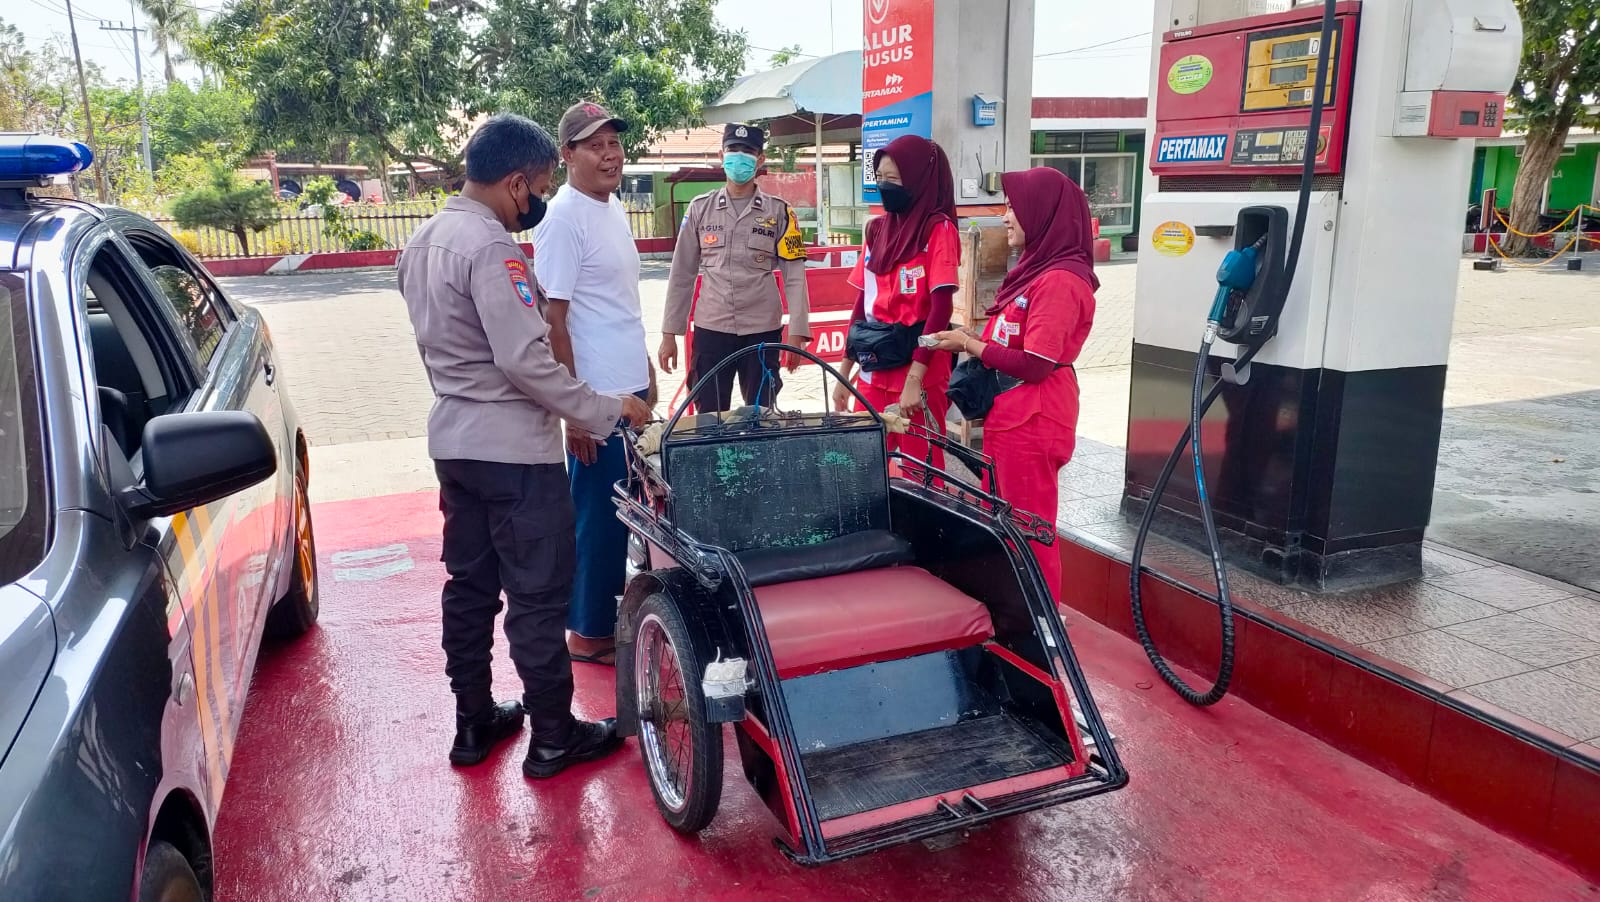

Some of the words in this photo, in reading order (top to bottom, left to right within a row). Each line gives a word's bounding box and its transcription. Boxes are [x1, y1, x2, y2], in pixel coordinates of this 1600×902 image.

[1159, 137, 1226, 162] PERTAMAX
[701, 224, 724, 232] AGUS
[752, 227, 775, 238] POLRI
